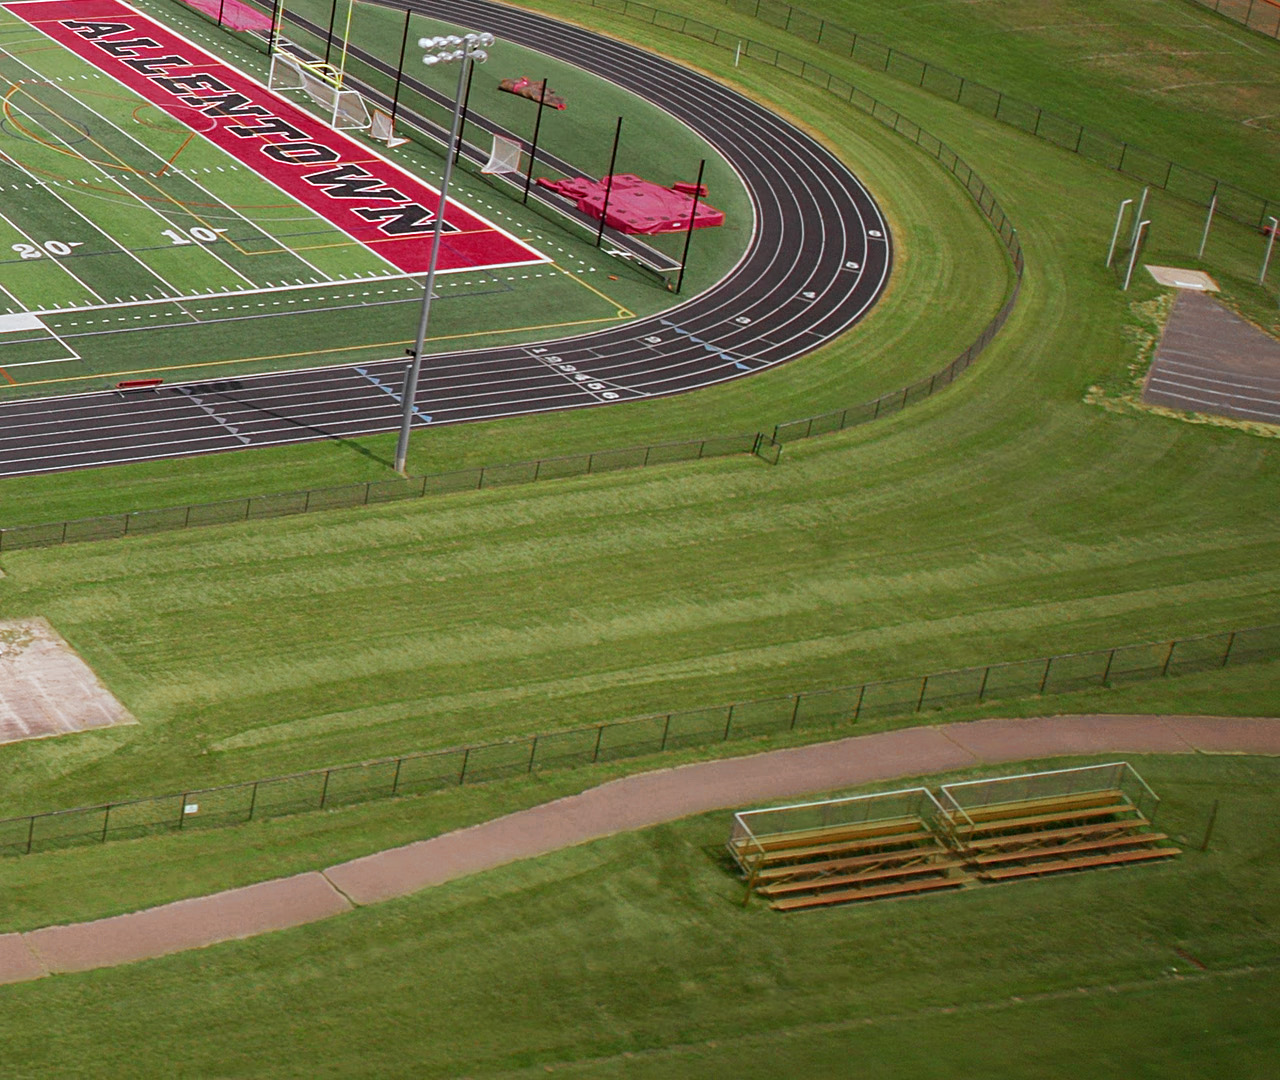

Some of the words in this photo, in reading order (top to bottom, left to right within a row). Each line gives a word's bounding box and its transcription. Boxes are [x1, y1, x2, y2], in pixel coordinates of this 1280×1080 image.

[57, 19, 462, 237] ALLENTOWN
[161, 227, 218, 245] 10
[11, 240, 71, 259] 20
[574, 373, 591, 381] 4
[587, 382, 606, 390] 5
